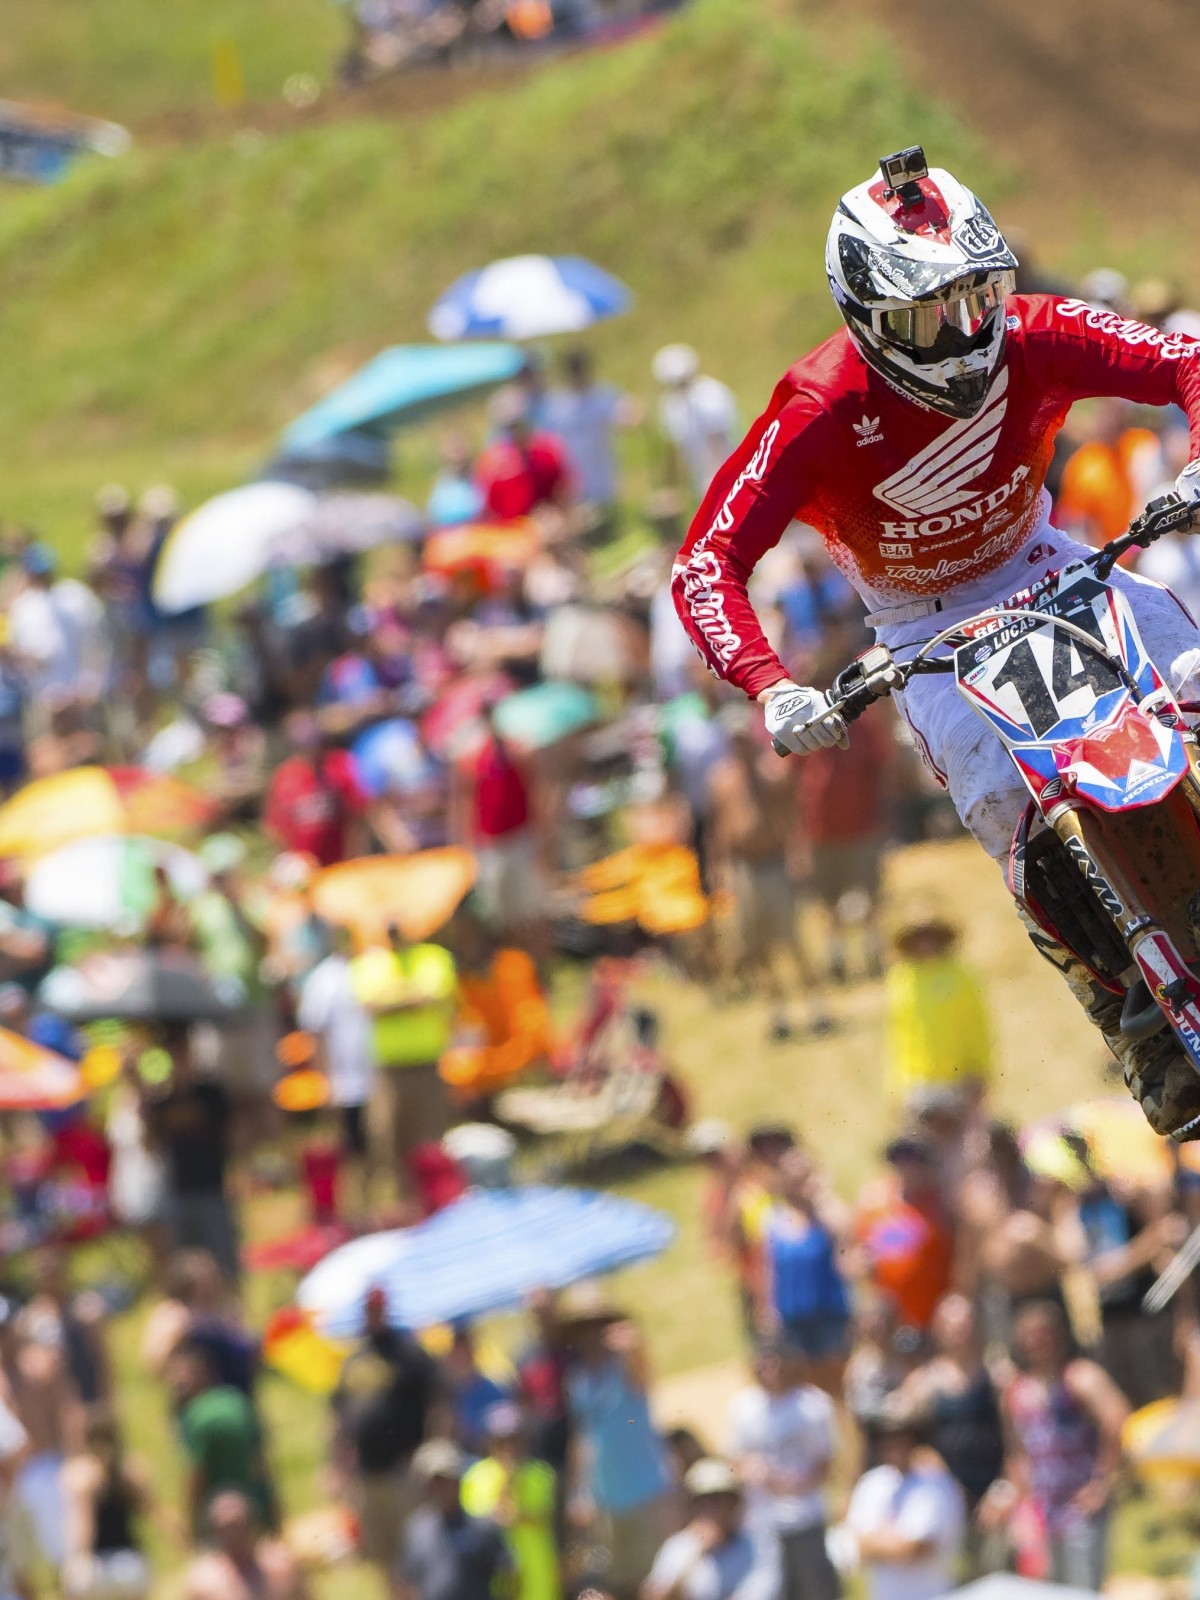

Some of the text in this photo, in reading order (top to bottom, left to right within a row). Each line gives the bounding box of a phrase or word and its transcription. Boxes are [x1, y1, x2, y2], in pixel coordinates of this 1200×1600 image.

[942, 261, 1009, 281] HONDA
[856, 433, 884, 447] adidas
[880, 464, 1031, 539] HONDA
[1153, 507, 1189, 531] ARC
[929, 531, 975, 551] DUNLOP
[885, 564, 934, 585] Troy
[932, 559, 973, 581] Lee
[992, 602, 1062, 651] LUCAS OIL
[992, 606, 1123, 740] 14
[1121, 772, 1178, 804] HONDA
